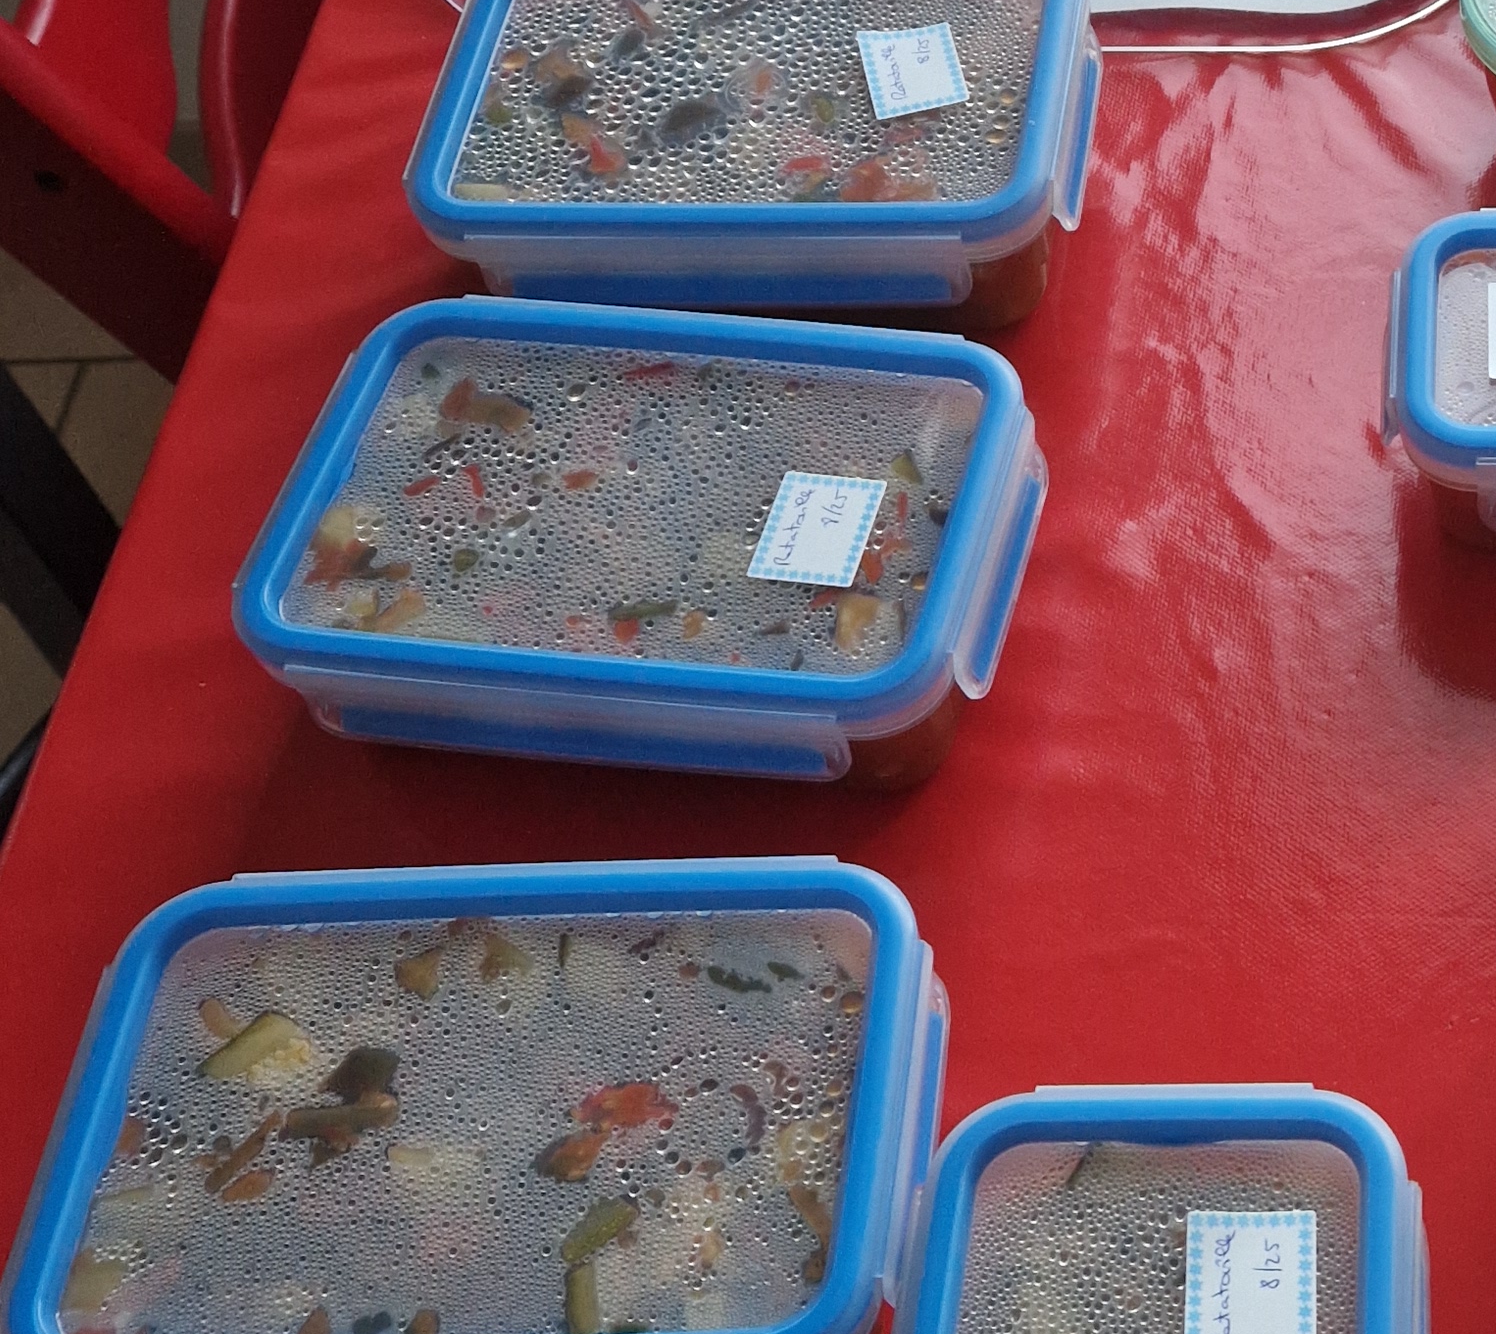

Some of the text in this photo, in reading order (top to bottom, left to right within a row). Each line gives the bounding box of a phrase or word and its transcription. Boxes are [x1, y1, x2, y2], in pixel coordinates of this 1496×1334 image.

[911, 38, 931, 64] 8/25
[821, 488, 848, 527] 8/25
[1252, 1238, 1283, 1289] 8/25
